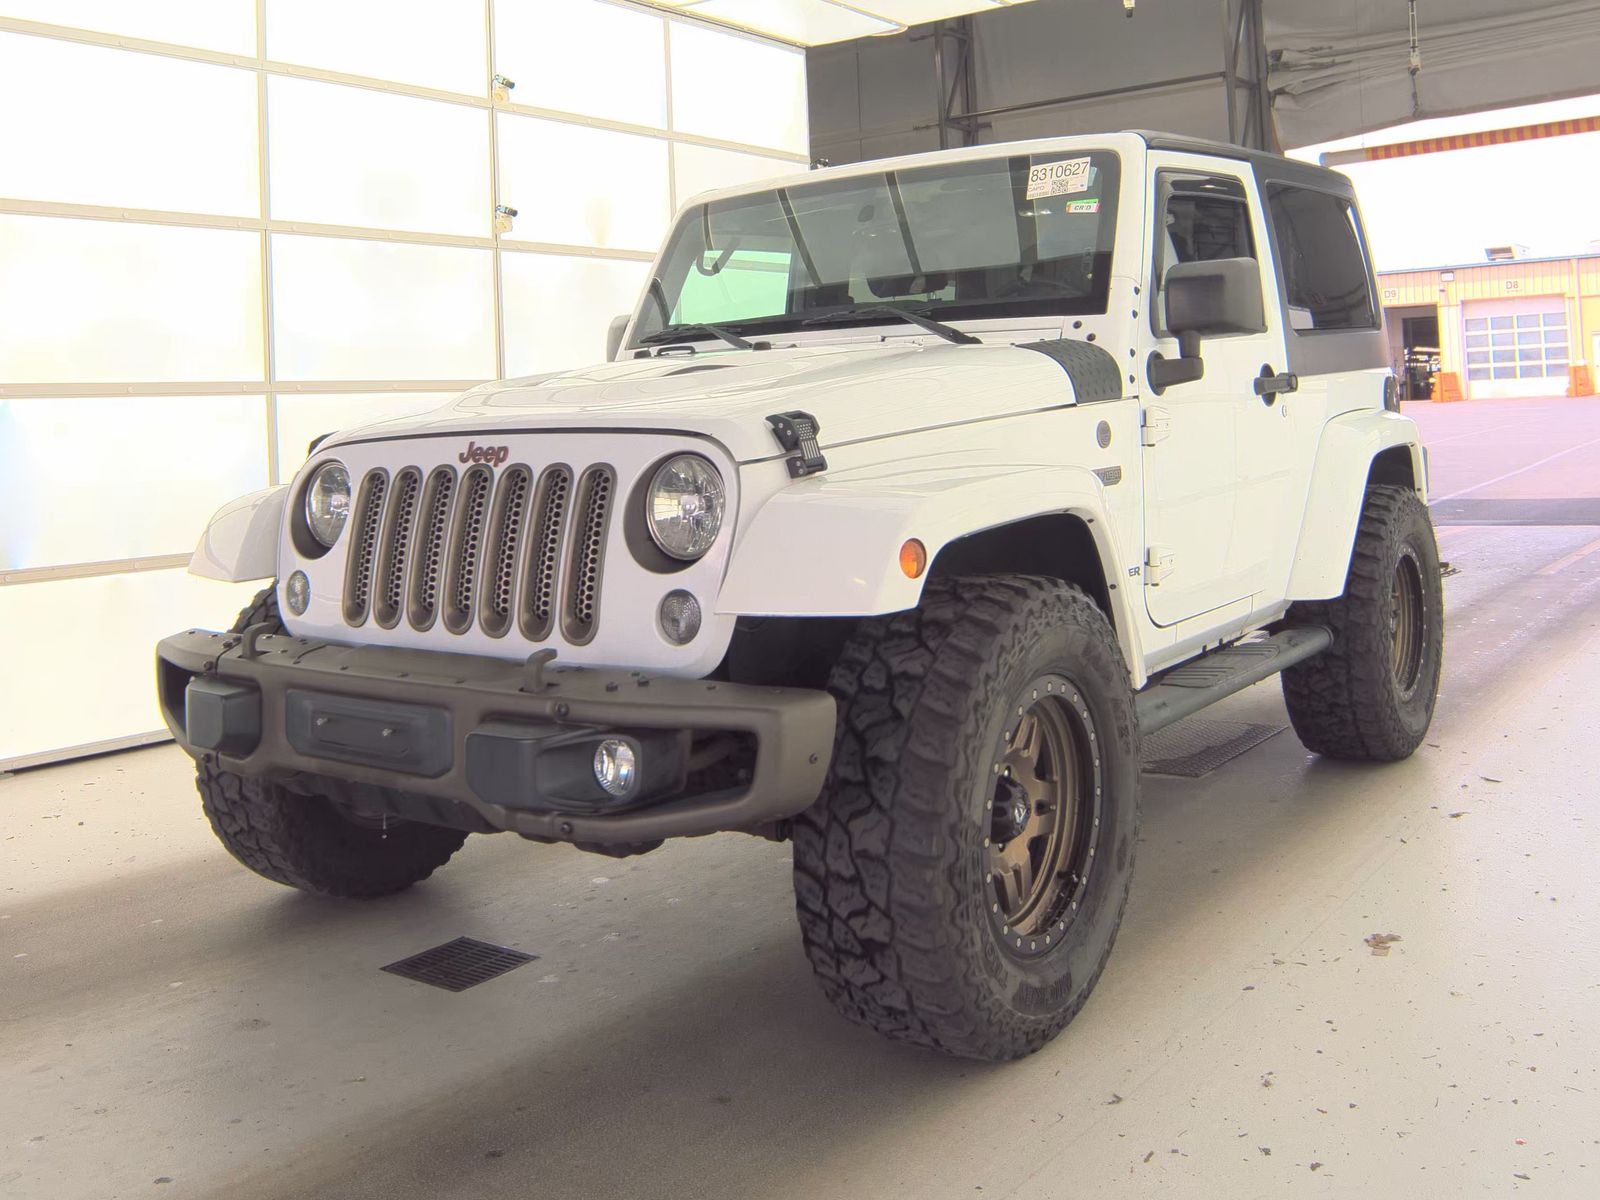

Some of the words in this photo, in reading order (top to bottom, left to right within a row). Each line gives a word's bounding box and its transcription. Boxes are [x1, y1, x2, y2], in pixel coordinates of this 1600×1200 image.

[1031, 161, 1089, 182] 8310627
[1505, 280, 1519, 289] D8
[459, 441, 509, 468] Jeep
